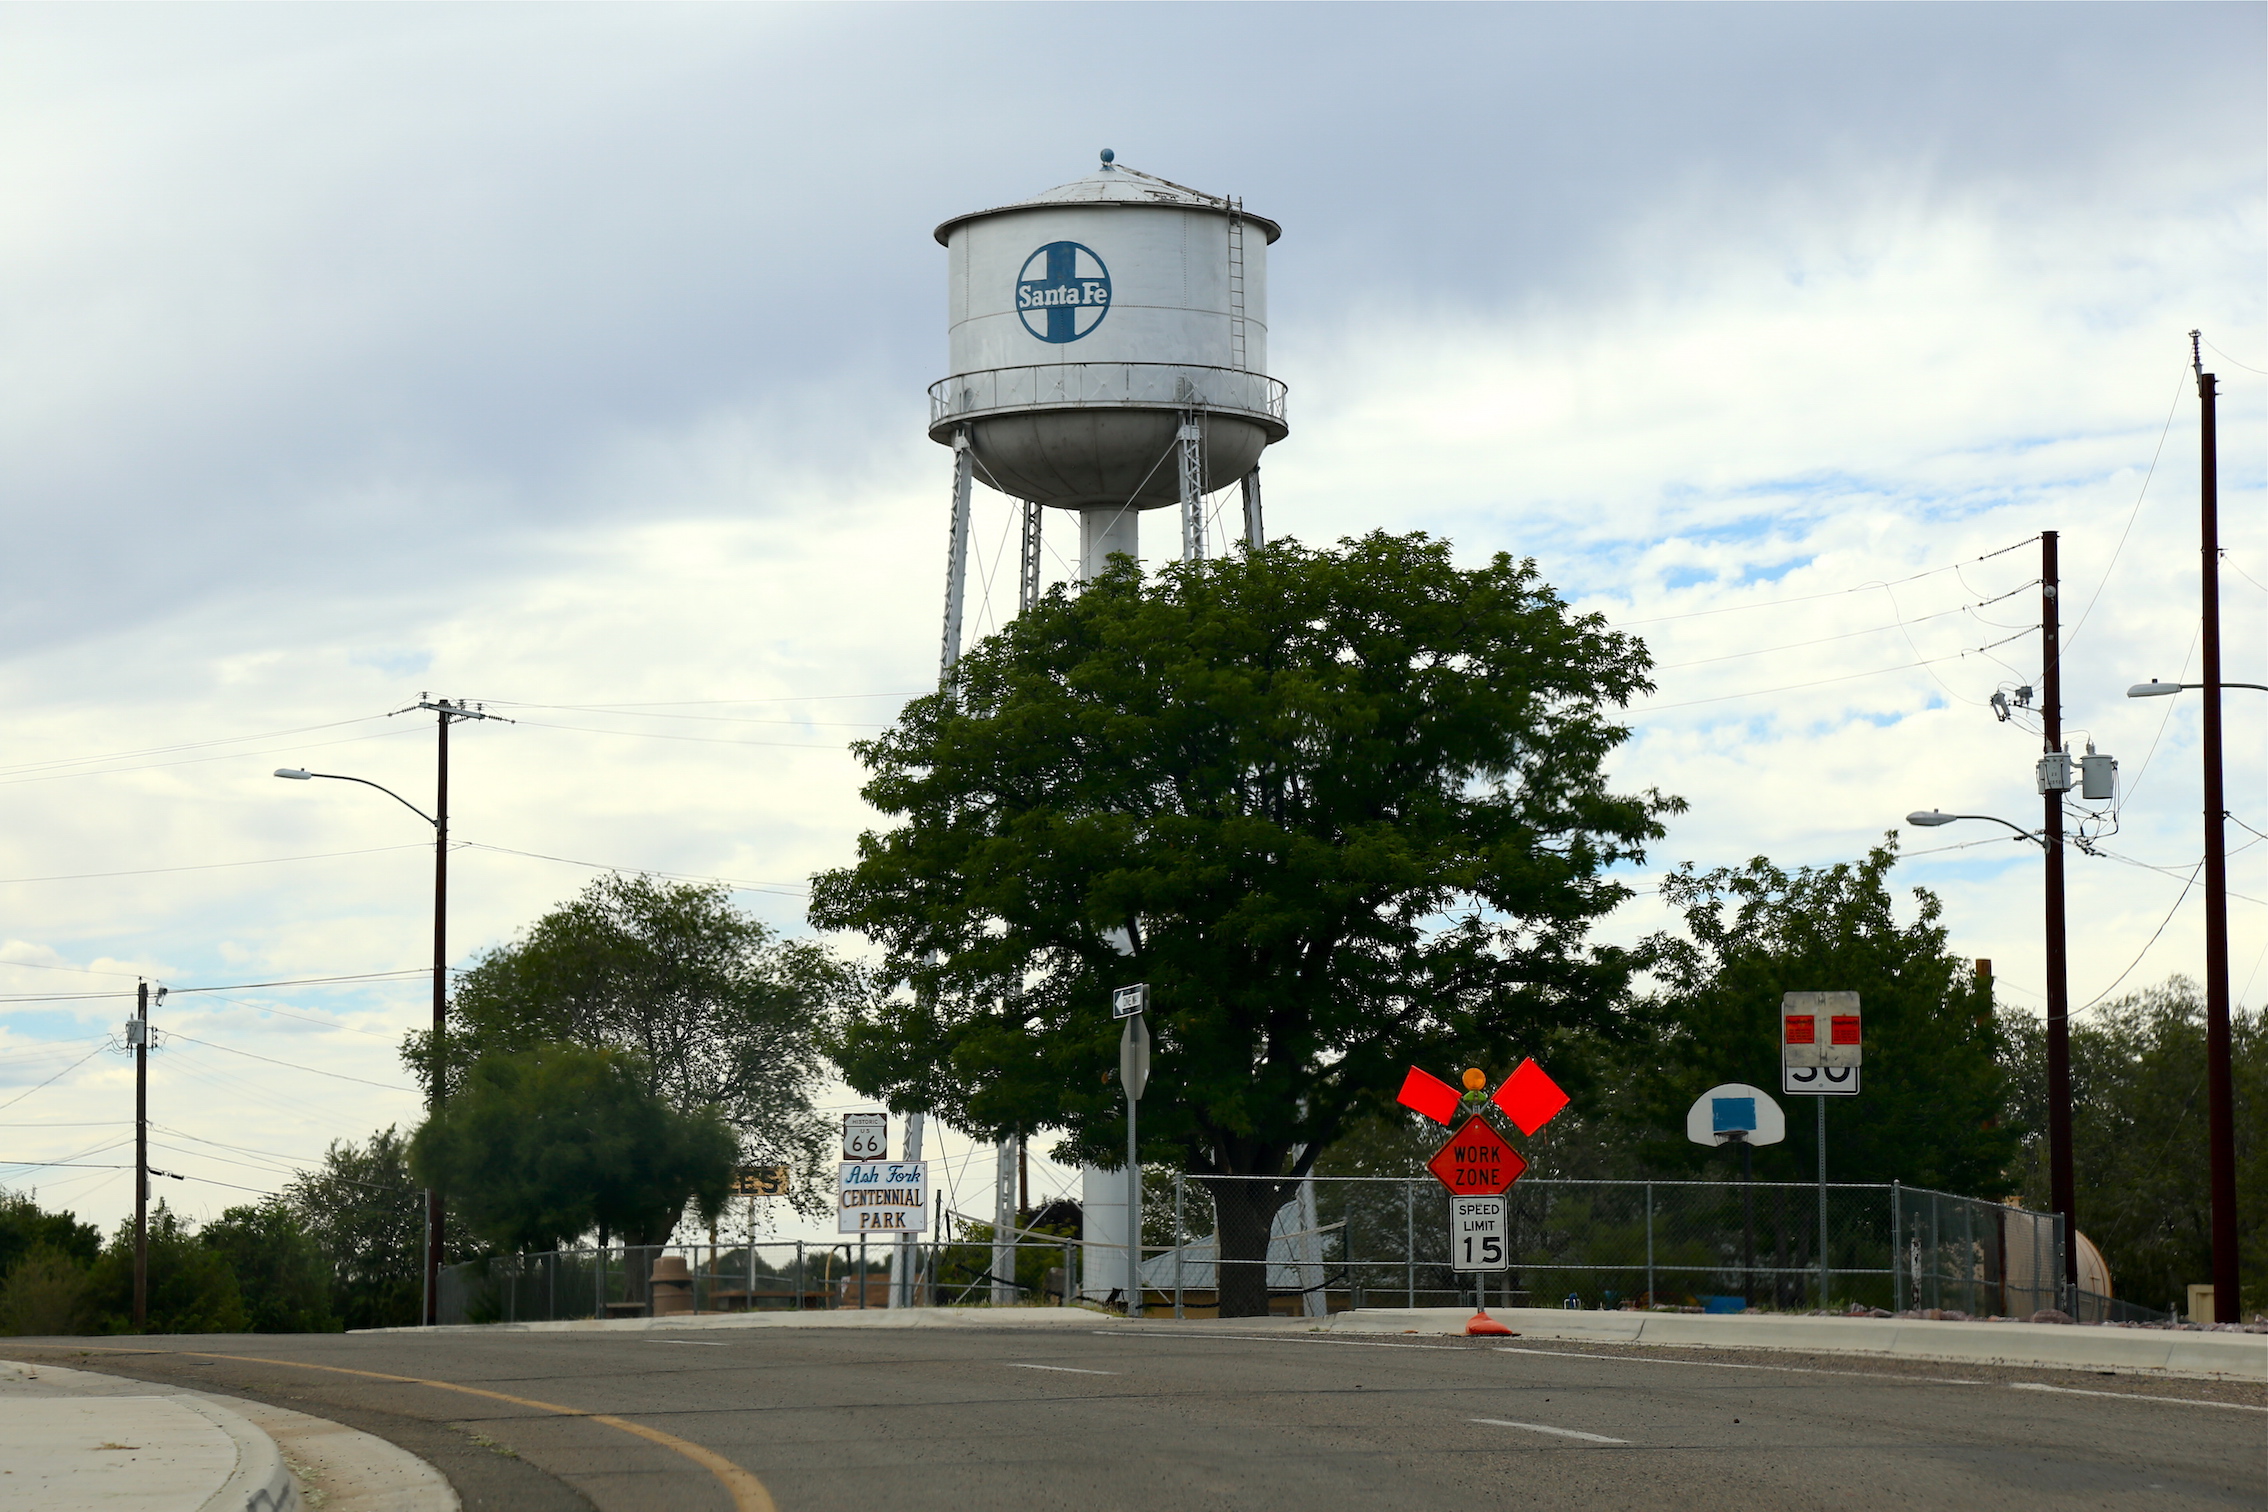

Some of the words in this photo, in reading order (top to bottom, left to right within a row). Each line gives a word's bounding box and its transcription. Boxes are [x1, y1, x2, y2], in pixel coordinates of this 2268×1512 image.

[1019, 285, 1080, 308] Santa
[1082, 282, 1108, 304] Fe
[852, 1135, 878, 1152] 66
[1454, 1146, 1501, 1163] WORK
[727, 1170, 780, 1194] ES
[845, 1165, 879, 1184] Ash
[886, 1165, 921, 1183] Fork
[1455, 1168, 1501, 1186] ZONE
[842, 1188, 924, 1209] CENTENNIAL
[1459, 1204, 1500, 1215] SPEED
[859, 1212, 906, 1229] PARK
[1464, 1220, 1495, 1232] LIMIT
[1463, 1236, 1502, 1264] 15
